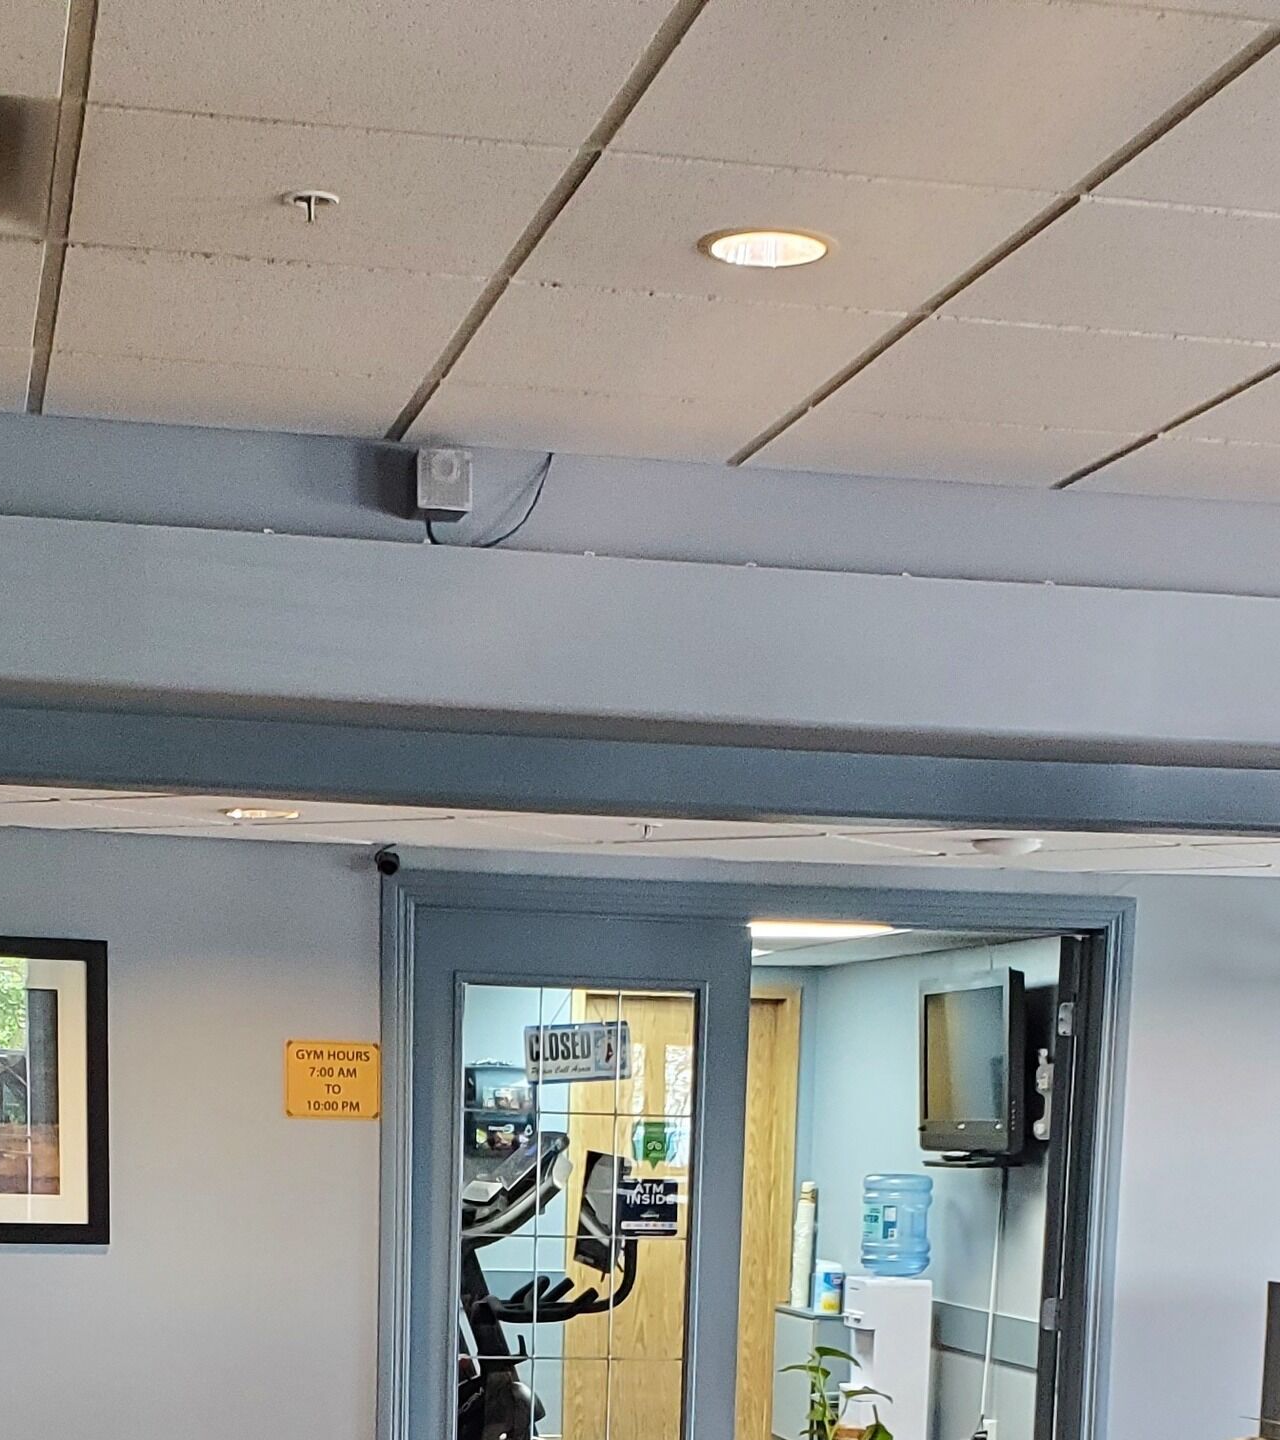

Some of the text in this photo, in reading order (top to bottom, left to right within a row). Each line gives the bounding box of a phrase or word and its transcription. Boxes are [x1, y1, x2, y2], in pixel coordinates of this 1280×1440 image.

[528, 1030, 592, 1062] CLOSED
[295, 1049, 370, 1062] GYM HOURS
[308, 1066, 357, 1078] 7:00 AM
[325, 1084, 342, 1095] TO
[307, 1100, 360, 1112] 10:00 PM
[635, 1183, 664, 1194] ATM
